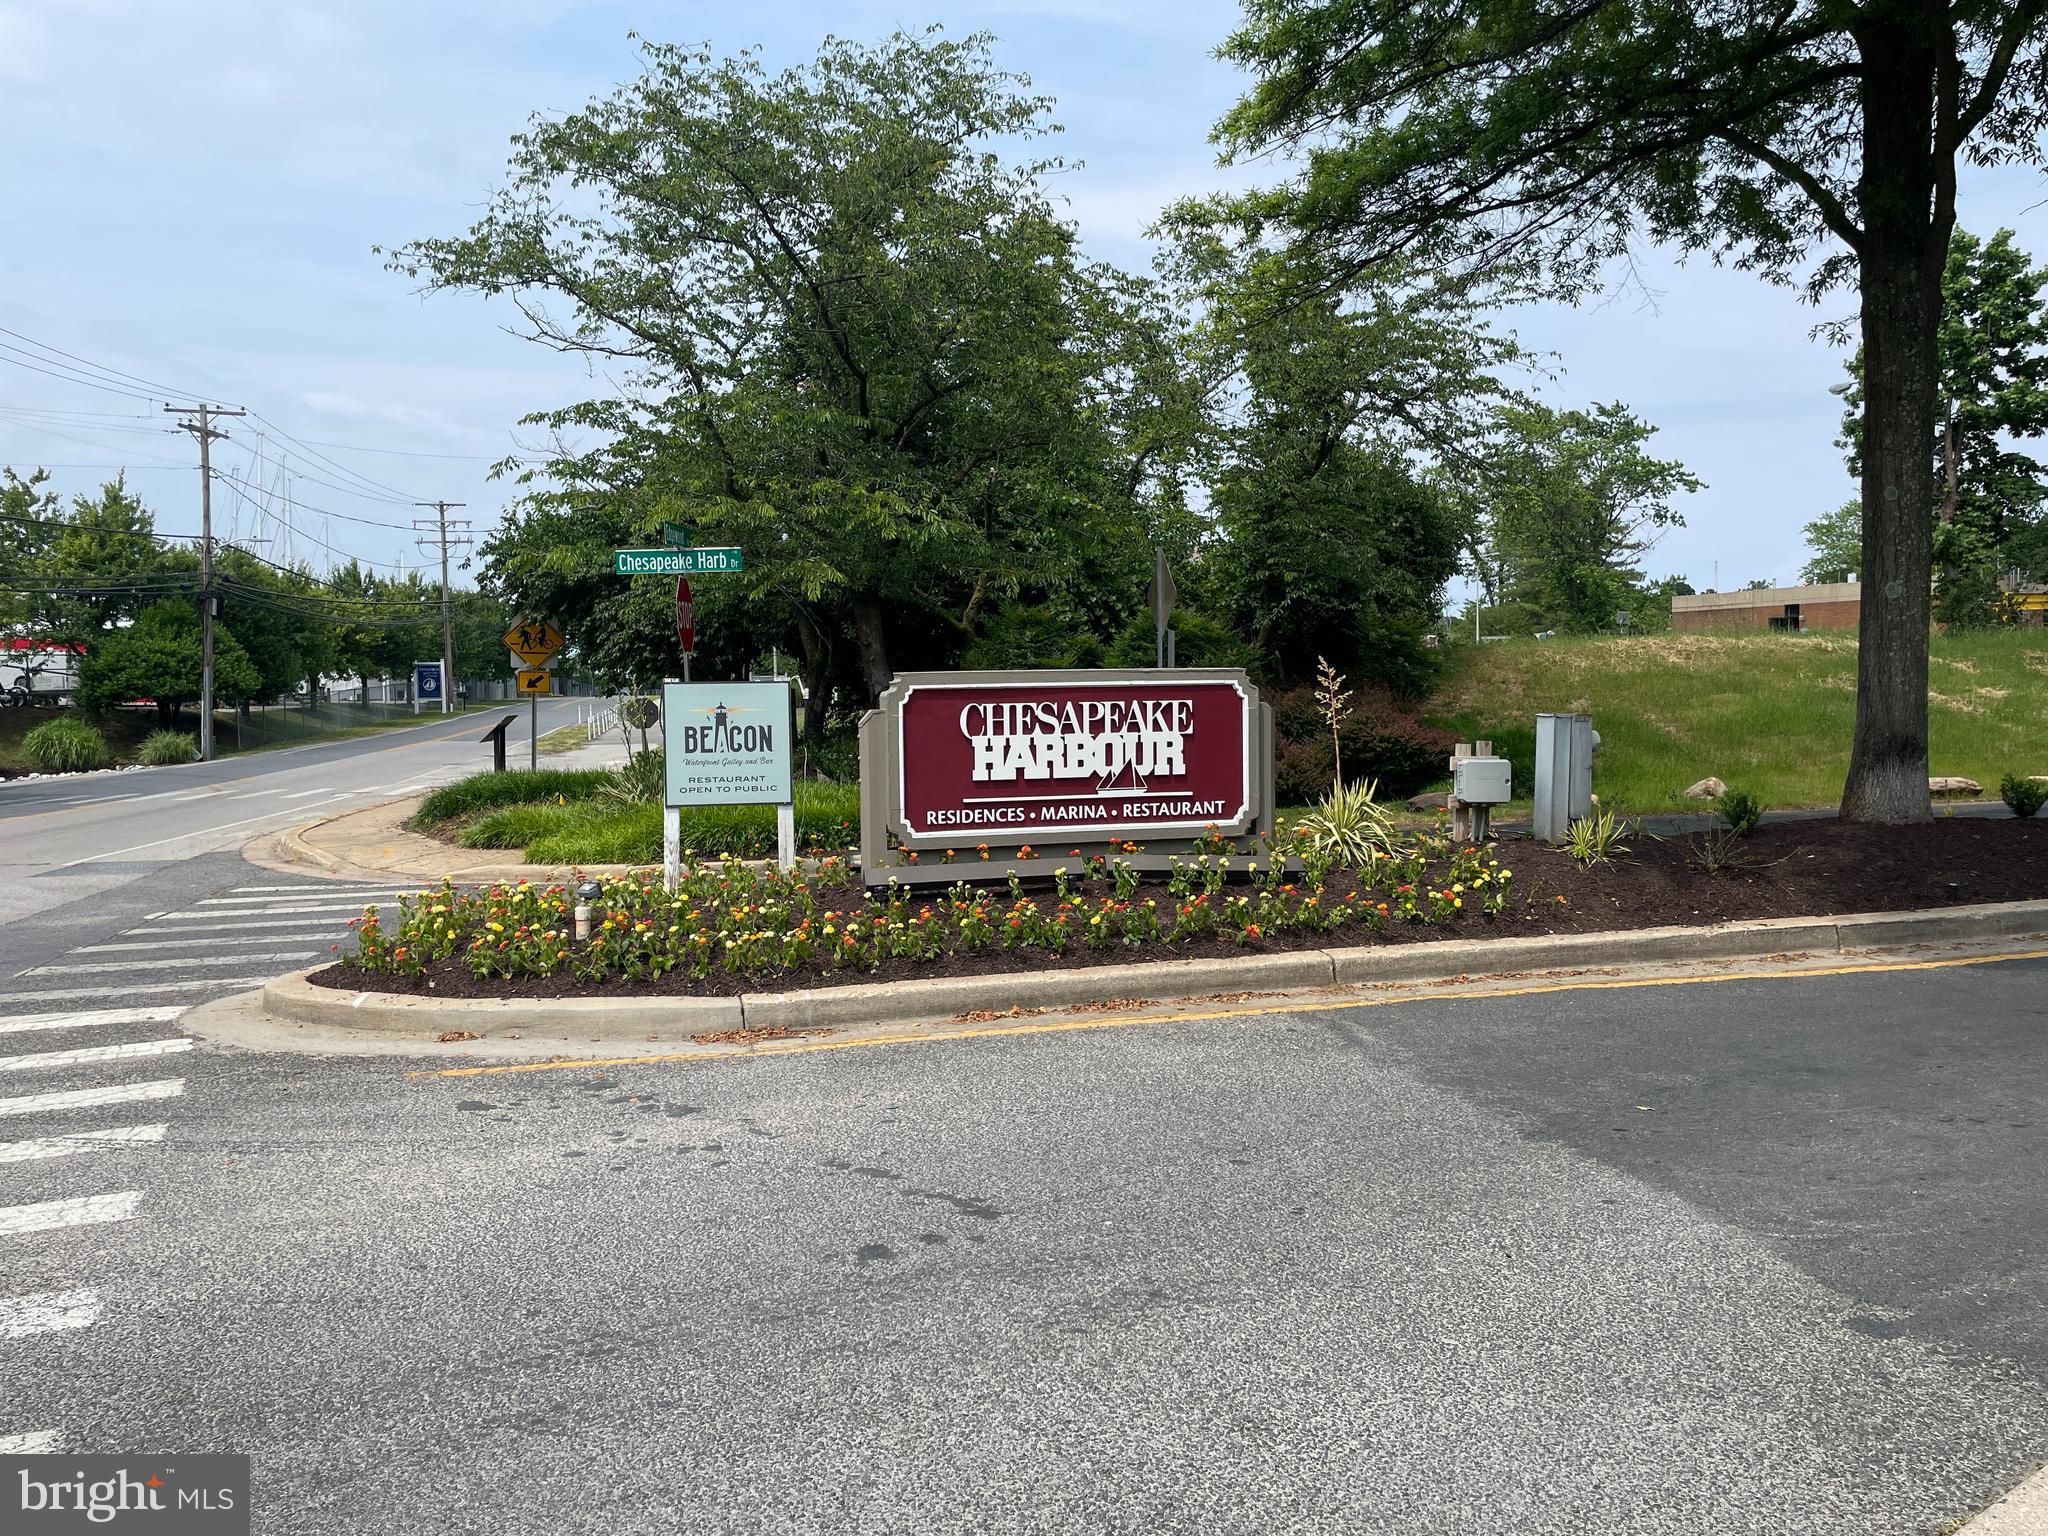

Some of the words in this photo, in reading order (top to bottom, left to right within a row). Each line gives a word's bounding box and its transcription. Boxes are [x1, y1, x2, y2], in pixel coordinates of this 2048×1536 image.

[619, 553, 693, 573] Chesapeake
[698, 552, 727, 569] Harb
[731, 559, 739, 568] Dr
[678, 602, 693, 629] STOP
[960, 699, 1194, 740] CHESAPEAKE
[684, 724, 774, 754] BEACON
[683, 758, 720, 767] Waterfront
[721, 757, 743, 767] Galley
[745, 757, 758, 765] and
[760, 756, 773, 765] Bar
[972, 731, 1186, 782] HARBOUR
[680, 786, 712, 794] OPEN
[688, 775, 766, 783] RESTAURANT
[926, 807, 1026, 826] RESIDENCES
[1040, 804, 1107, 821] MARINA
[1122, 800, 1225, 818] RESTAURANT
